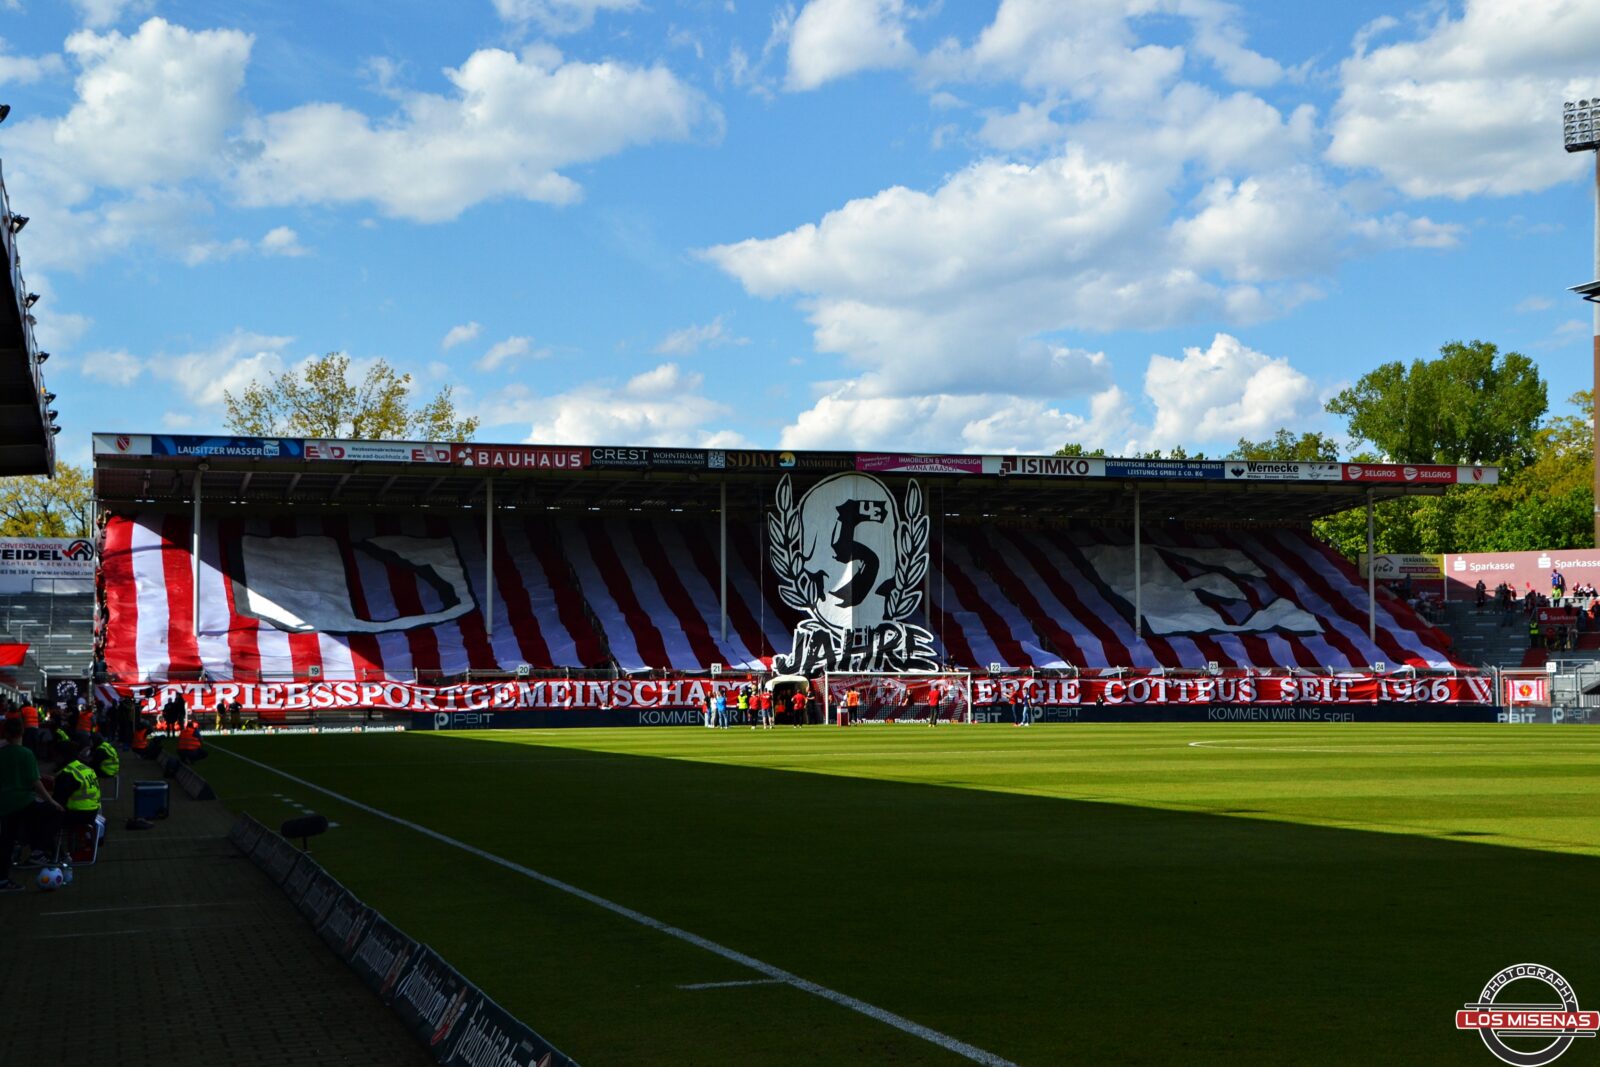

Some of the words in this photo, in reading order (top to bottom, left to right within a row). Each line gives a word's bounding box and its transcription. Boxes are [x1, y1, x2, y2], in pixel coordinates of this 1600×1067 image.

[178, 446, 225, 456] LAUSITZER
[226, 446, 262, 456] WASSER
[592, 448, 648, 460] CREST
[478, 452, 580, 468] BAUHAUS
[726, 452, 776, 468] SDIM
[1022, 458, 1089, 474] ISIMKO
[1246, 462, 1299, 472] Wernecke
[0, 549, 62, 560] EIDEL
[1469, 561, 1515, 572] Sparkasse
[1554, 559, 1600, 569] Sparkasse
[772, 620, 938, 674] JAHRE
[1104, 678, 1258, 704] COTTBUS
[1280, 678, 1354, 703] SEIT
[1378, 678, 1451, 703] 1966
[1048, 708, 1082, 717] PBIT
[1208, 708, 1269, 720] KOMMEN
[1272, 708, 1296, 720] WIR
[1300, 708, 1321, 720] INS
[454, 713, 494, 724] PBIT
